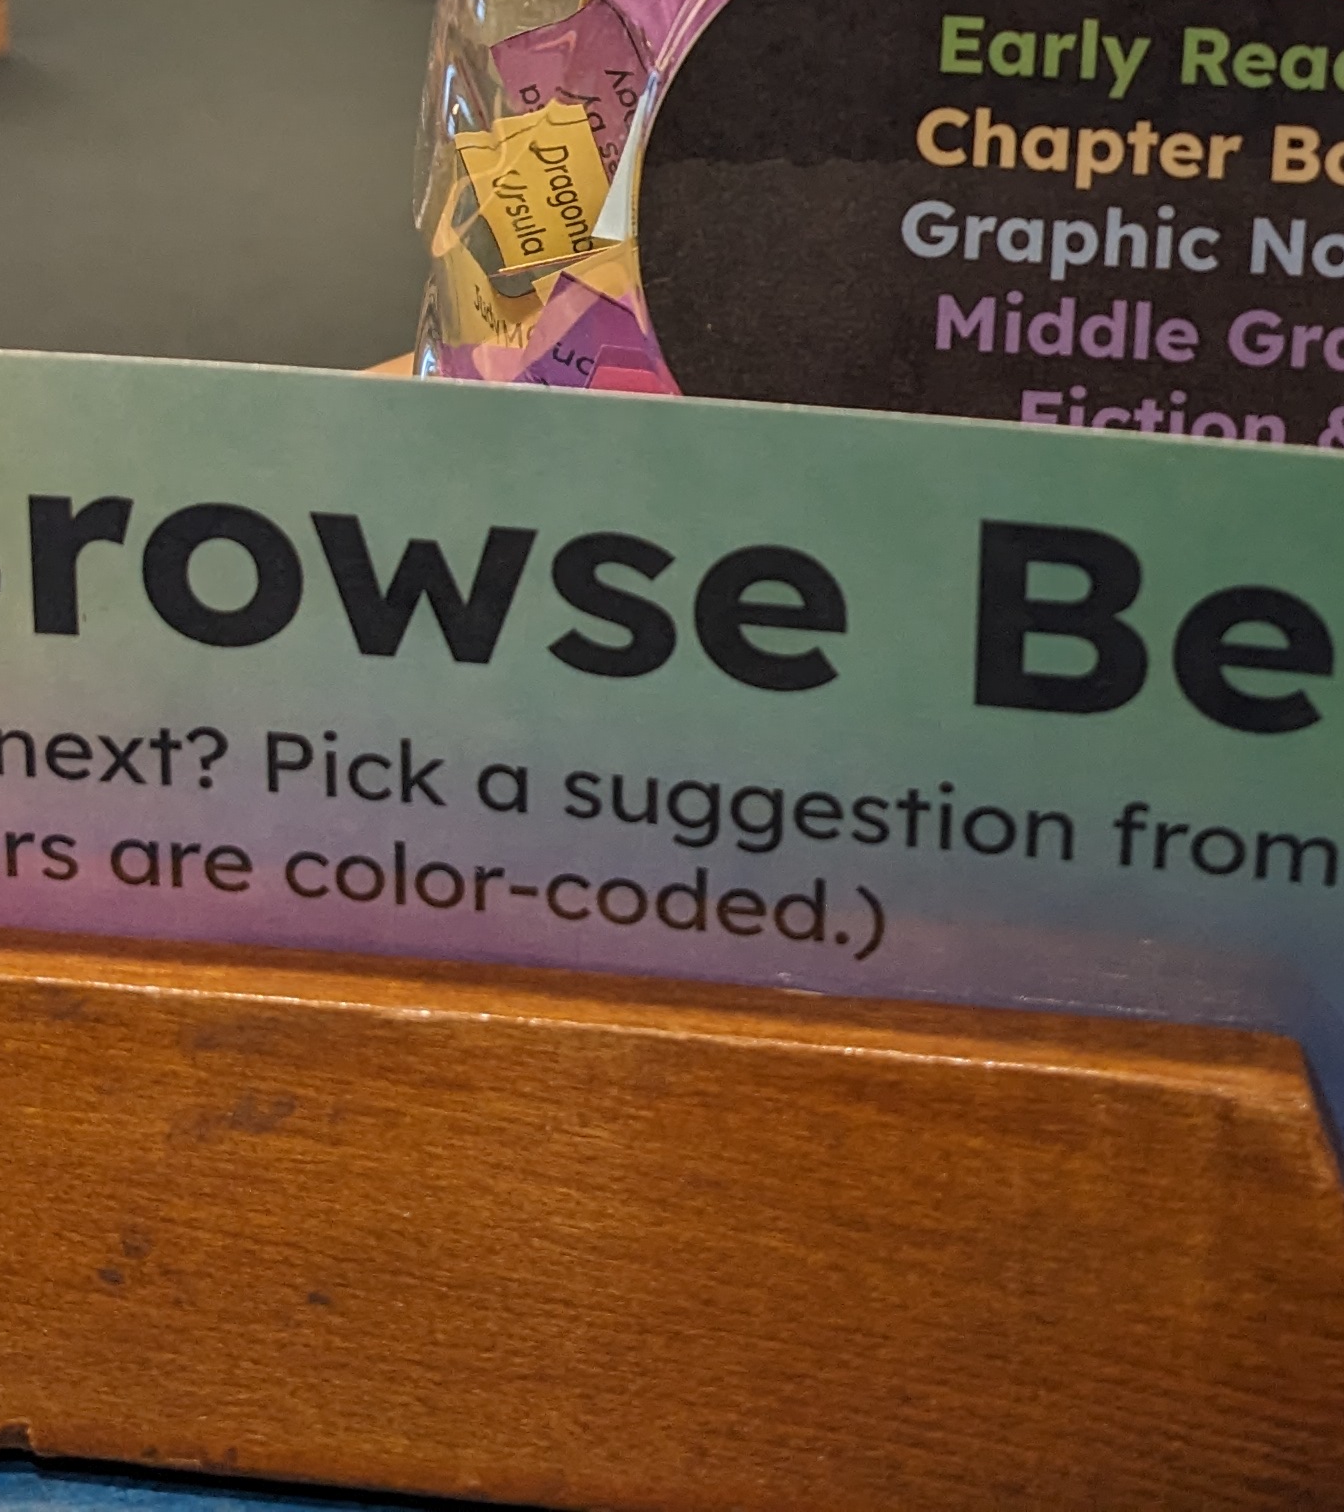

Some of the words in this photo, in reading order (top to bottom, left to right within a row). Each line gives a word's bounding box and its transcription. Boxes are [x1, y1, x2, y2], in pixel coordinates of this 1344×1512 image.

[939, 14, 1151, 98] Early
[916, 107, 1244, 190] Chapter
[492, 170, 547, 257] Ursula
[901, 200, 1220, 281] Graphic
[935, 291, 1199, 362] Middle
[1021, 386, 1285, 445] Fiction
[265, 730, 446, 810] Pick
[479, 756, 529, 816] a
[562, 752, 1075, 863] suggestion
[1112, 803, 1338, 889] from
[110, 830, 254, 892] are
[285, 840, 888, 960] color-coded.)
